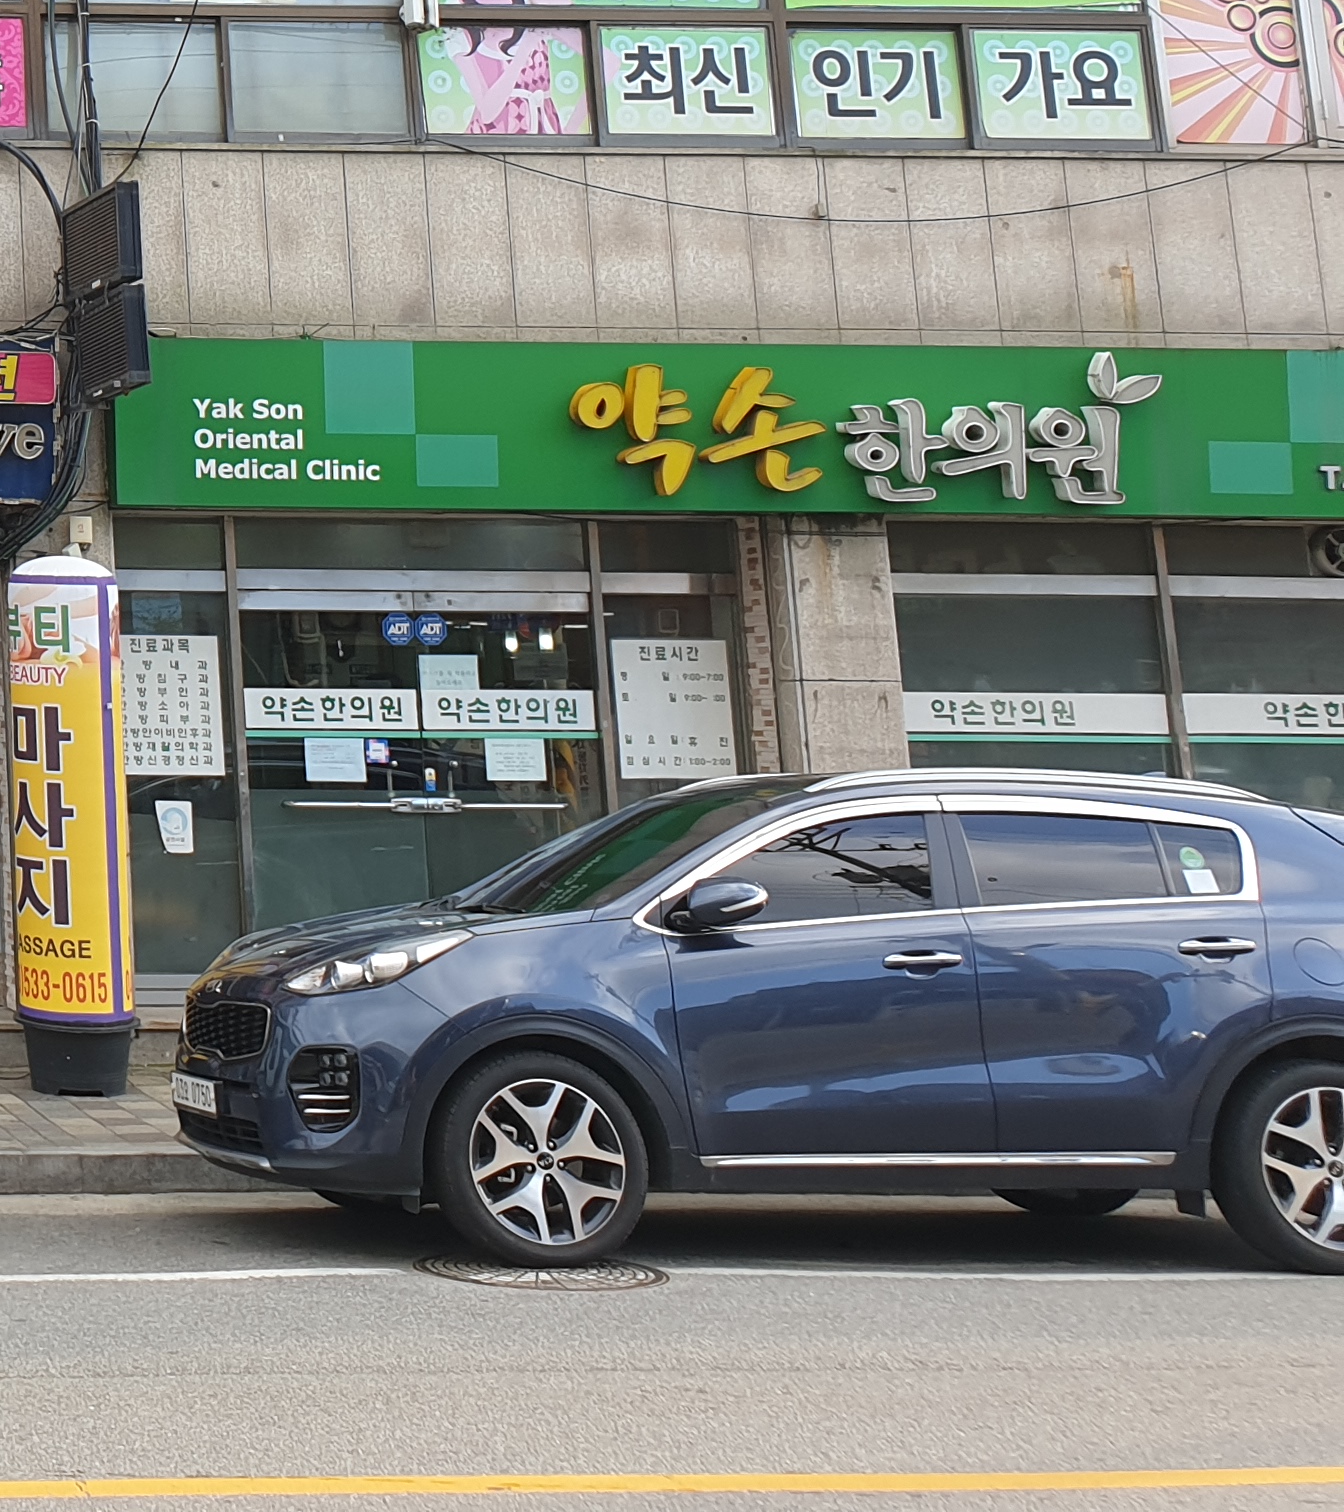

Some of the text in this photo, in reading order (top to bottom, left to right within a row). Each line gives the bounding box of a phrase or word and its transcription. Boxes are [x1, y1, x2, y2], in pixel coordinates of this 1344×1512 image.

[623, 44, 1133, 122] 최신 인기 가요
[193, 398, 303, 421] Yak Son
[193, 428, 304, 451] Oriental
[568, 363, 1127, 505] 약손 한의원
[194, 458, 381, 482] Medical Clinic
[387, 623, 410, 635] ADT
[420, 625, 442, 635] ADT
[129, 638, 191, 653] 진료과목
[638, 646, 699, 662] 진료시간
[261, 695, 403, 723] 약손한의원
[437, 697, 579, 724] 약손한의원
[931, 699, 1076, 727] 약손한의원
[18, 934, 93, 959] ASSAGE
